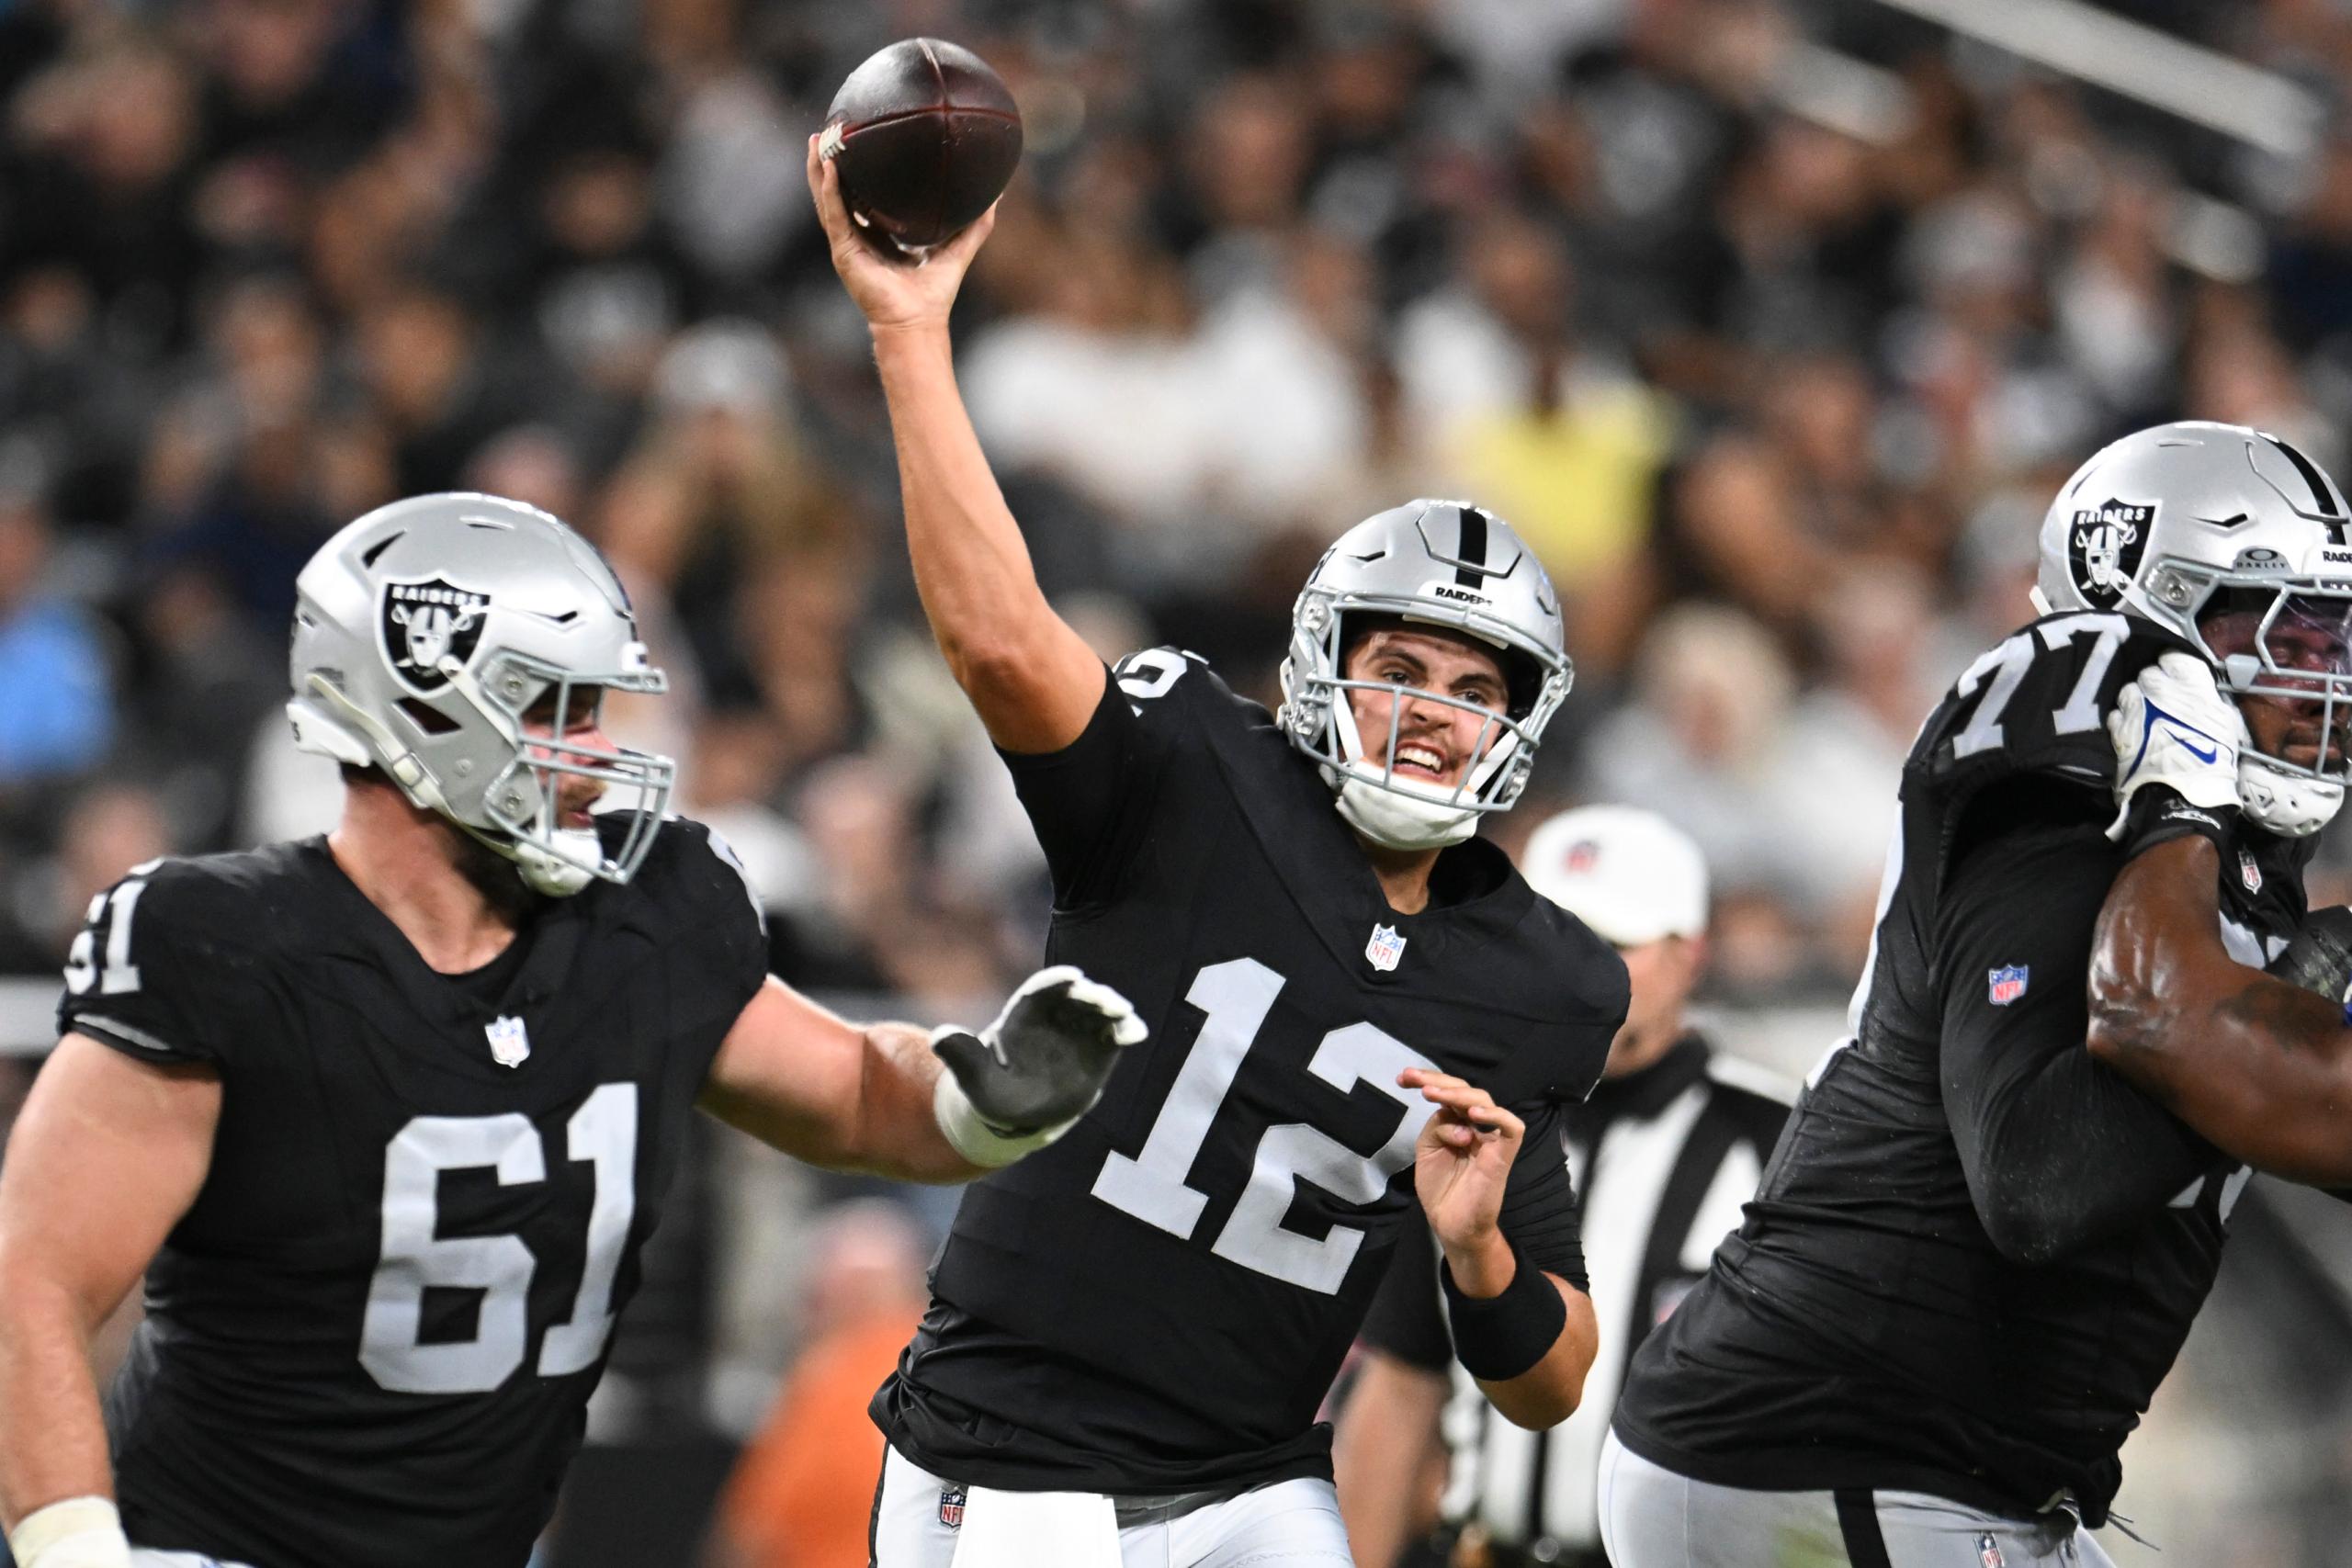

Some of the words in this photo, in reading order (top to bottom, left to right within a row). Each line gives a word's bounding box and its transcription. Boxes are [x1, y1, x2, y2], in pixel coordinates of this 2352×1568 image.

[2076, 507, 2146, 525] RAIDERS
[391, 585, 482, 607] RAIDERS
[1952, 613, 2131, 760] 77
[1090, 956, 1444, 1296] 12
[357, 1081, 639, 1394] 61
